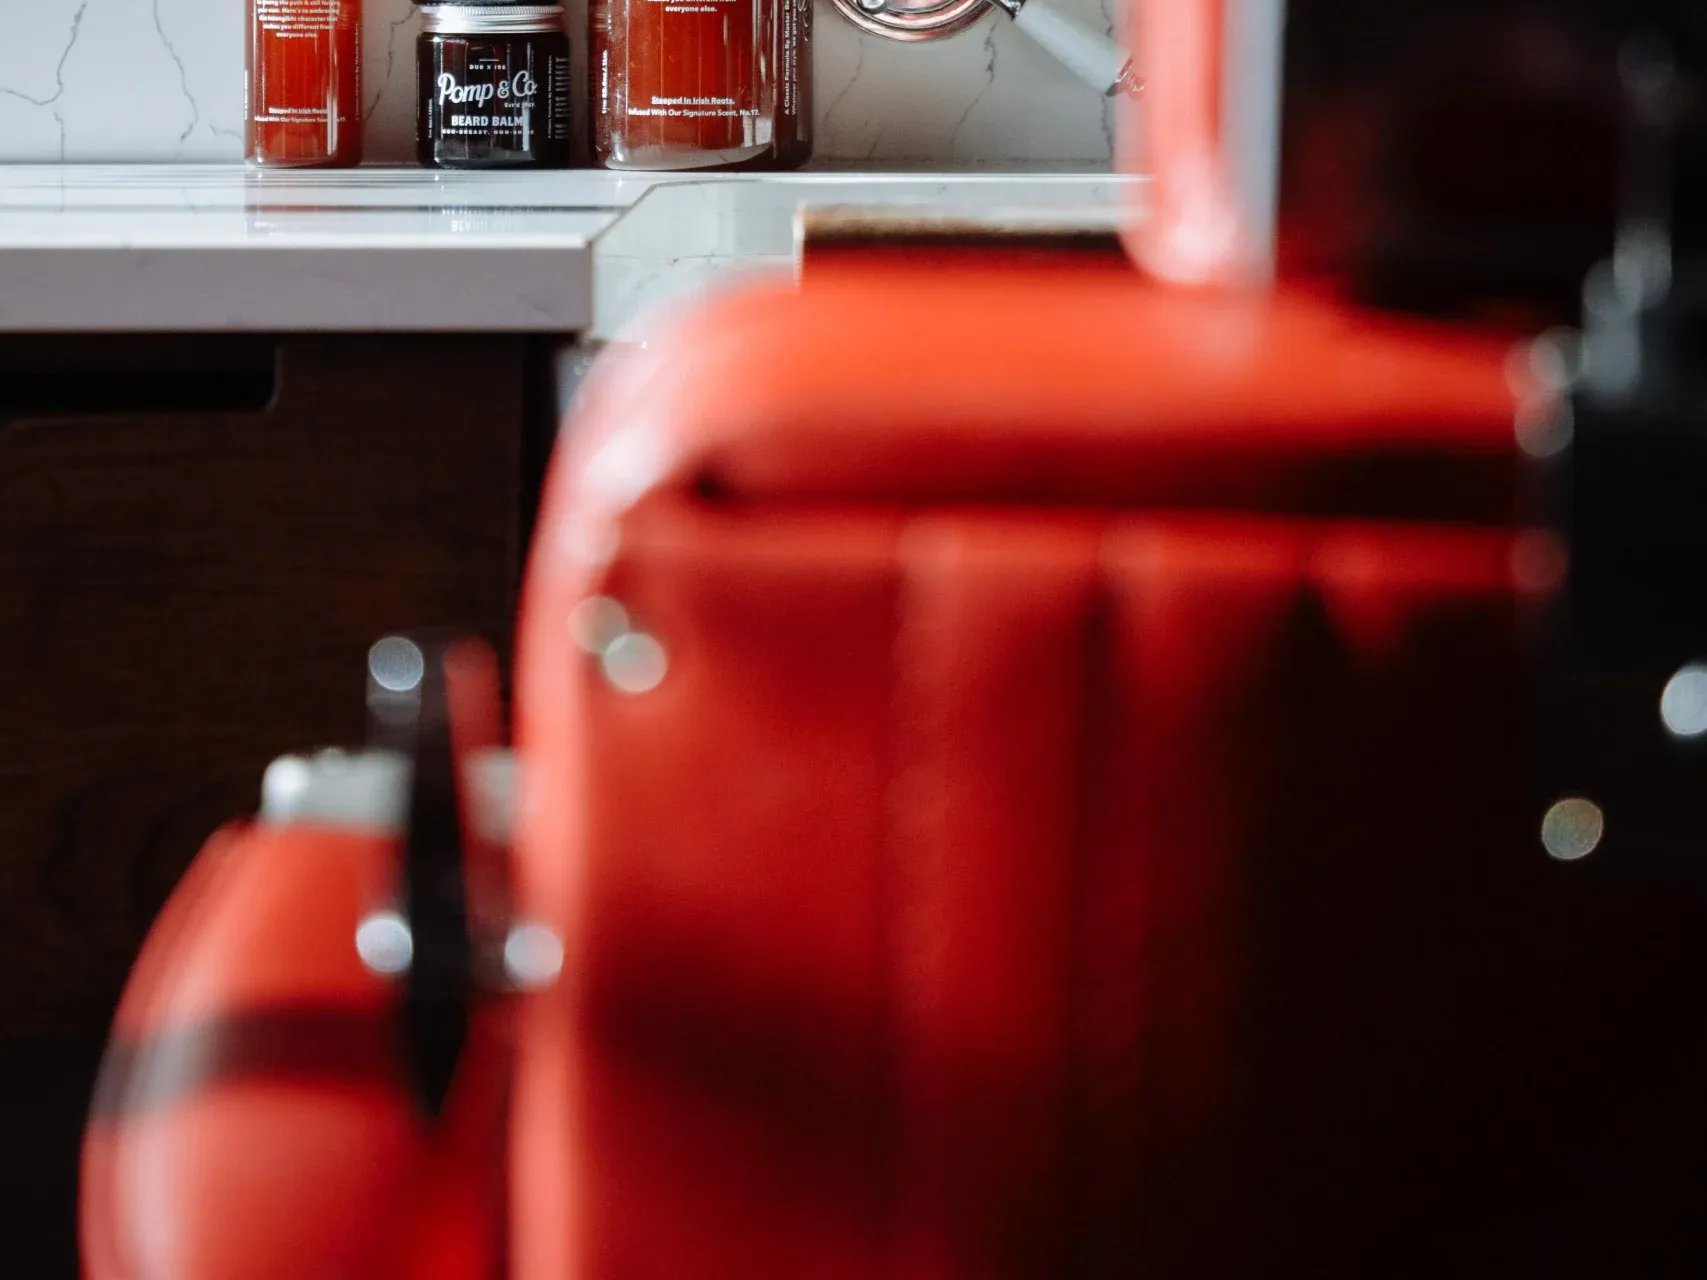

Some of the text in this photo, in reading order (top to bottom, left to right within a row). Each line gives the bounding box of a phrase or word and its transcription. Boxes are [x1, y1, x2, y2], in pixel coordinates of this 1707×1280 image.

[665, 5, 717, 13] everyone else.
[784, 39, 790, 49] By
[791, 36, 797, 47] we
[437, 73, 494, 108] Pomp
[497, 80, 509, 98] &
[652, 96, 682, 106] Steeped
[692, 96, 710, 106] Irish
[711, 96, 735, 106] Roots.
[651, 108, 666, 117] With
[668, 108, 681, 117] Our
[683, 108, 716, 117] Signature
[718, 108, 738, 117] Scent,
[451, 115, 523, 126] BEARD BALM
